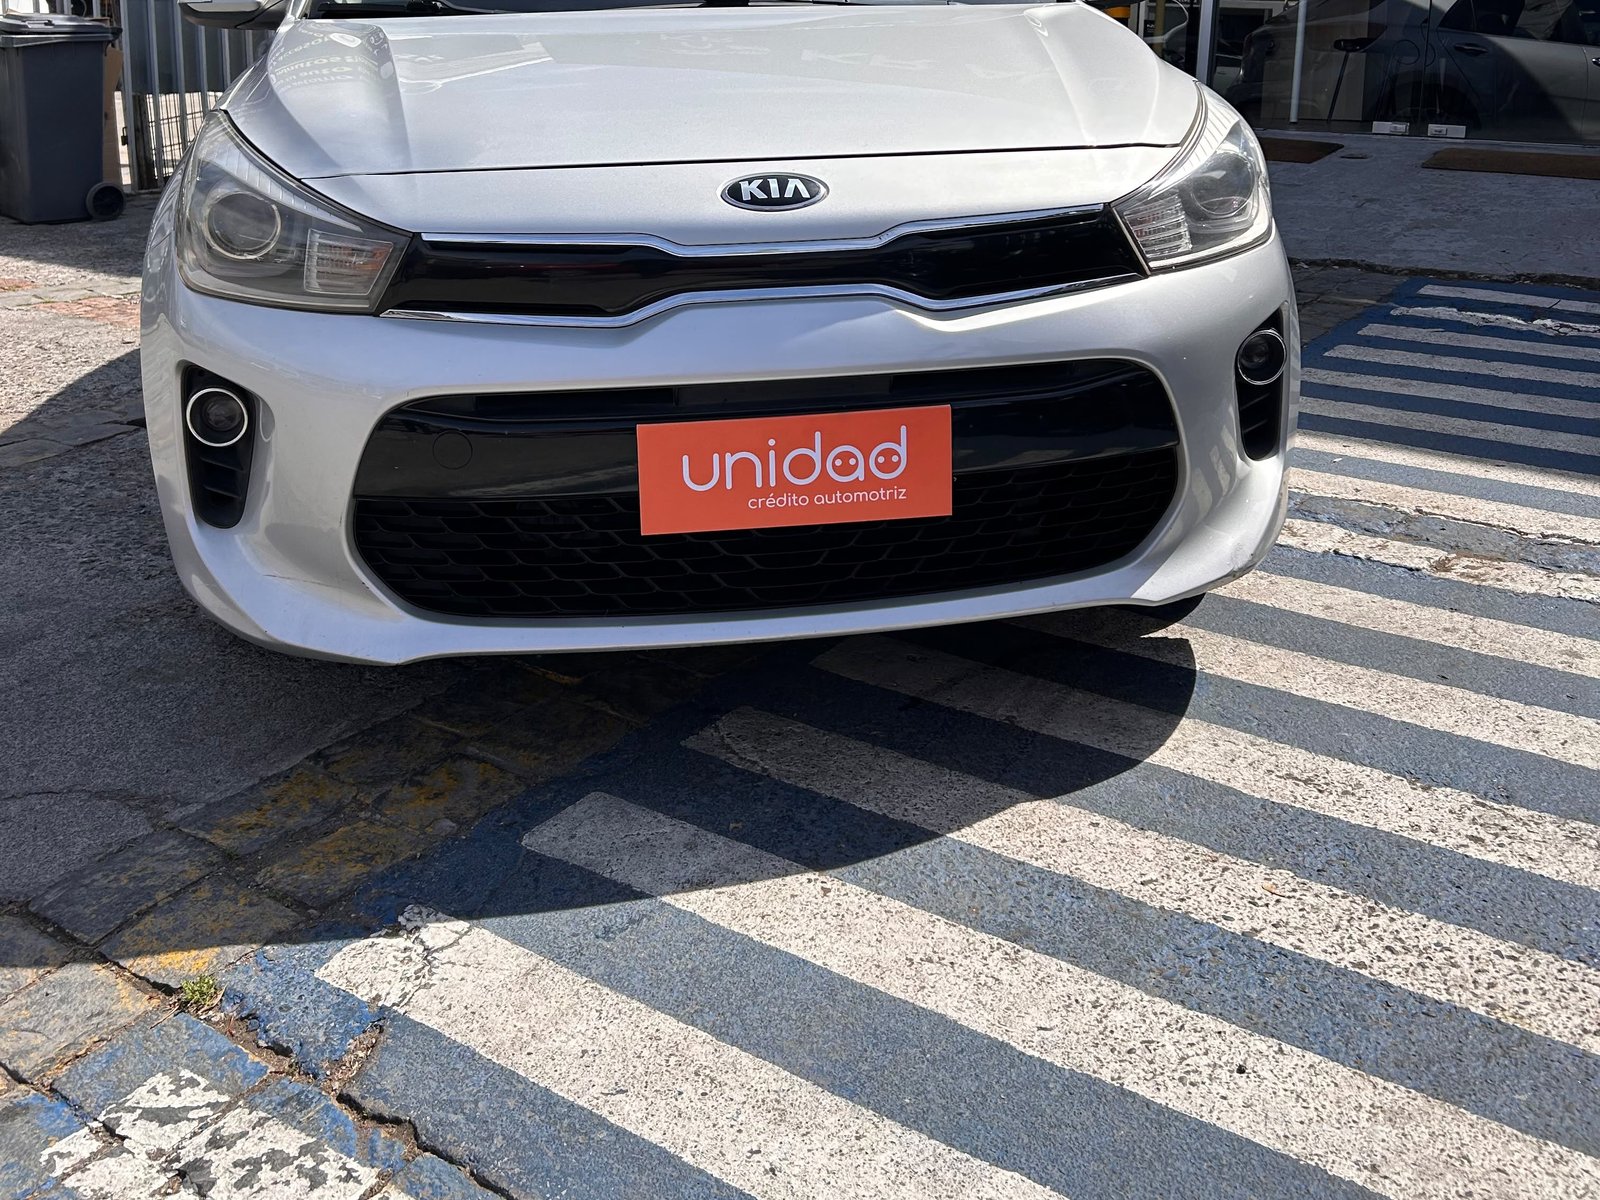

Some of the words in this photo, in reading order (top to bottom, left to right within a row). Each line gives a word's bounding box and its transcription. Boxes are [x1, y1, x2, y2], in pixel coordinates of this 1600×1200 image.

[739, 178, 811, 201] KIA
[682, 425, 908, 492] unidad
[748, 493, 809, 509] crédito
[814, 487, 907, 505] automotriz
